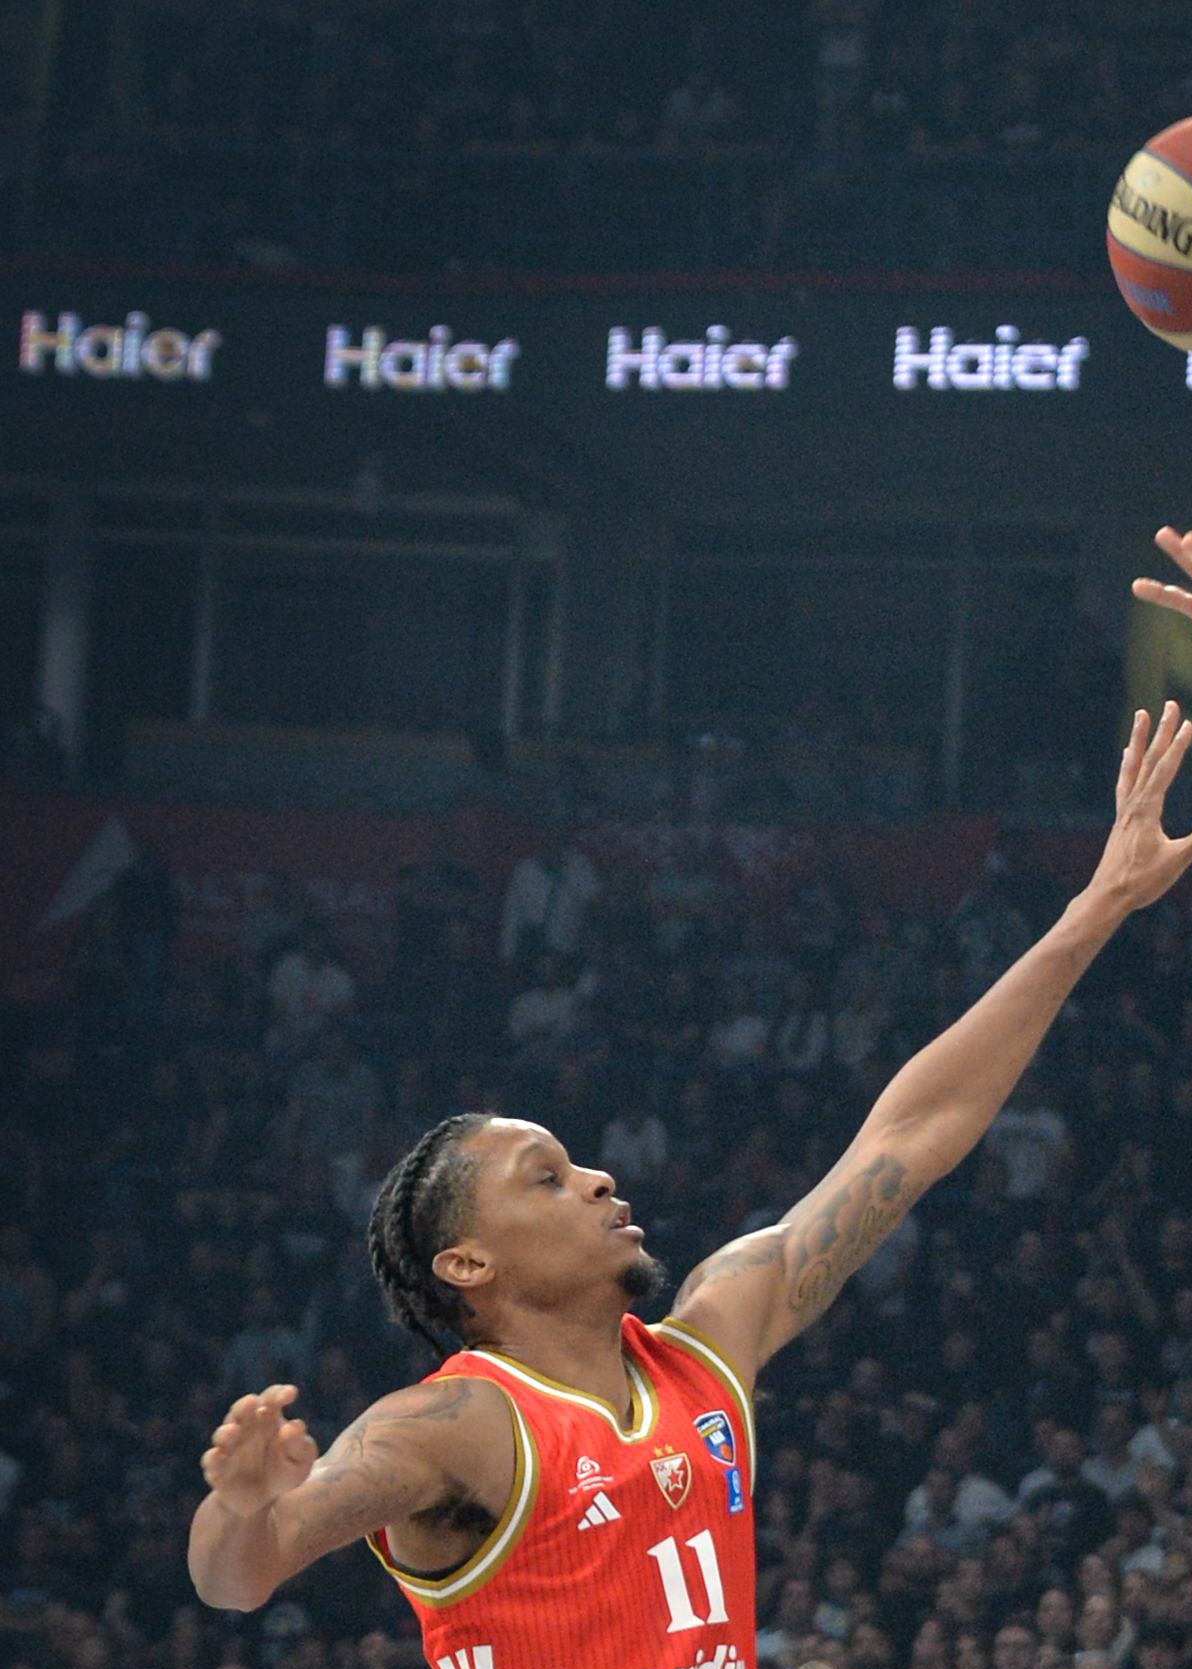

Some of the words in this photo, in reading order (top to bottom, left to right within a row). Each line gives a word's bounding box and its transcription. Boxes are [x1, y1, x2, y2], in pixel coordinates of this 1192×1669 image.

[22, 311, 222, 381] Haier
[325, 325, 521, 391] Haier
[606, 325, 798, 391] Haier
[893, 325, 1091, 392] Haier
[647, 1529, 730, 1634] 11
